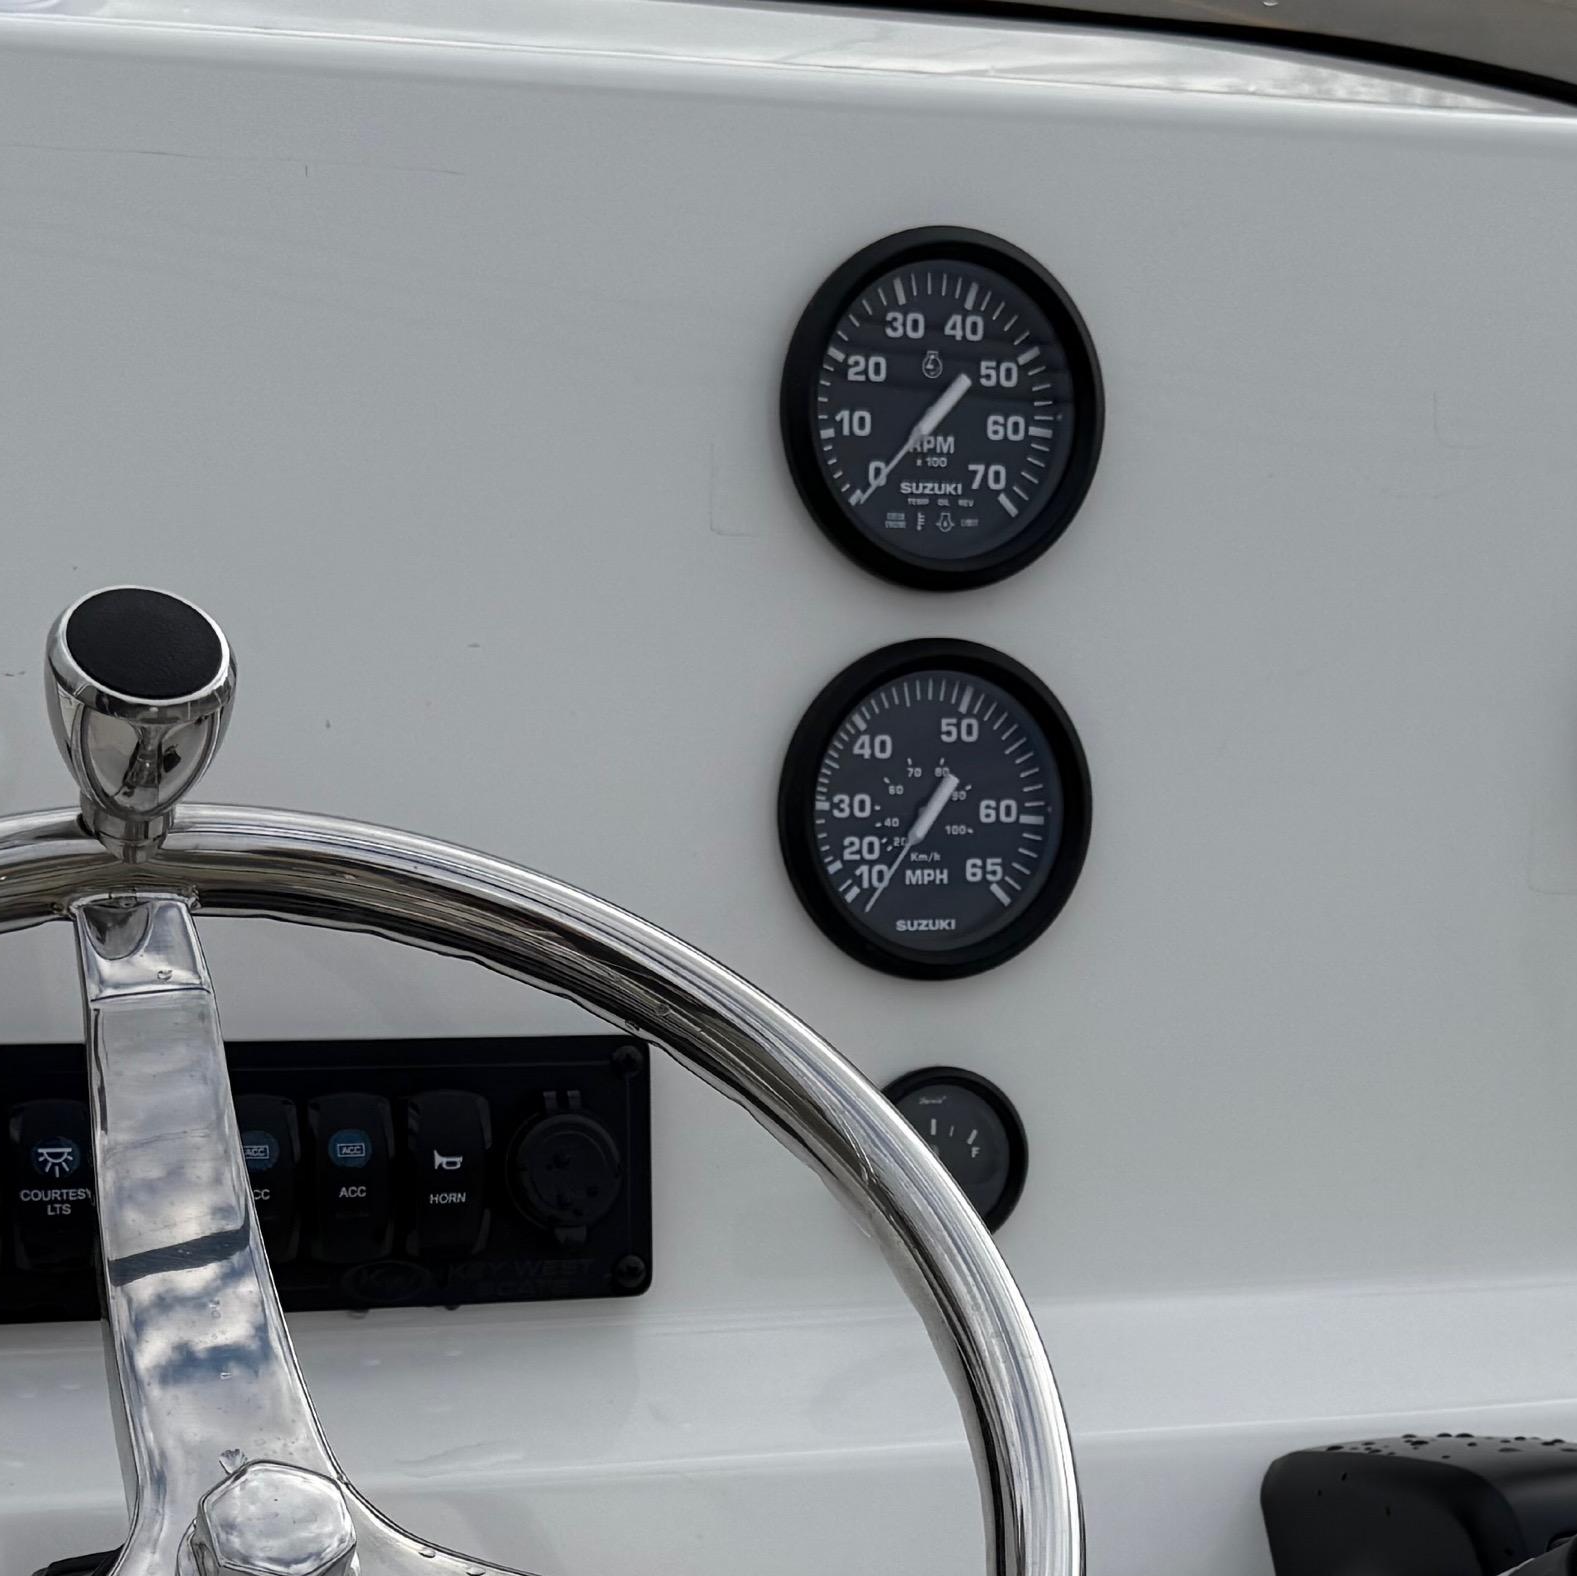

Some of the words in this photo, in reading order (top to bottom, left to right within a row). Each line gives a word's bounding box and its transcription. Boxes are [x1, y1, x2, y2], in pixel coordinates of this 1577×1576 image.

[885, 312, 924, 338] 30
[944, 314, 984, 341] 40
[847, 355, 887, 382] 20
[980, 361, 1018, 387] 50
[835, 410, 871, 436] 10
[986, 415, 1025, 441] 60
[926, 456, 947, 467] 100
[869, 461, 887, 487] 0
[968, 464, 1007, 490] 70
[900, 482, 962, 495] SUZUKI
[940, 718, 979, 743] 50
[853, 735, 892, 759] 40
[907, 767, 922, 778] 70
[832, 794, 871, 818] 30
[979, 799, 1018, 824] 60
[884, 818, 899, 827] 40
[945, 825, 967, 835] 100
[843, 836, 881, 861] 20
[854, 864, 889, 889] 10
[905, 869, 949, 885] MPH
[965, 858, 1003, 882] 65
[896, 919, 956, 931] SUZUKI
[342, 1145, 362, 1155] ACC
[971, 1147, 981, 1158] F
[253, 1188, 271, 1200] CC
[338, 1186, 367, 1198] ACC
[429, 1192, 466, 1204] HORN
[47, 1203, 72, 1216] LTS
